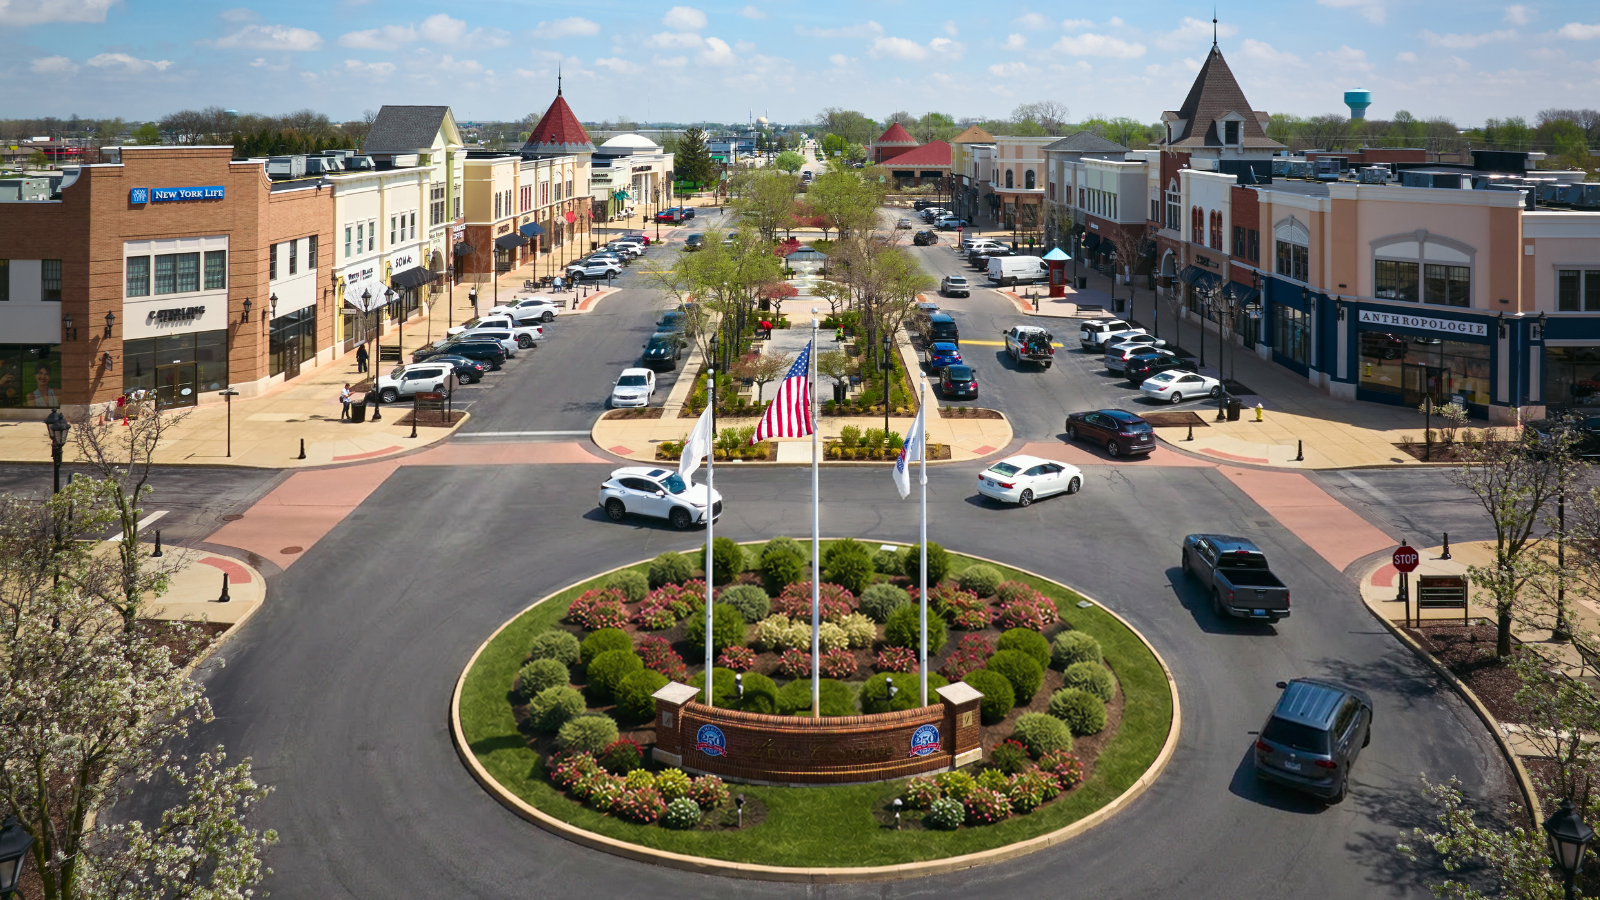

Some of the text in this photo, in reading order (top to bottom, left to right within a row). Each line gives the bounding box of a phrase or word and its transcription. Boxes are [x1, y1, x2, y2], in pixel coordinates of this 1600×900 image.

[155, 189, 223, 199] NEW YORK LIFE
[1362, 312, 1484, 334] ANTHROPOLOGIE
[1394, 553, 1417, 565] STOP
